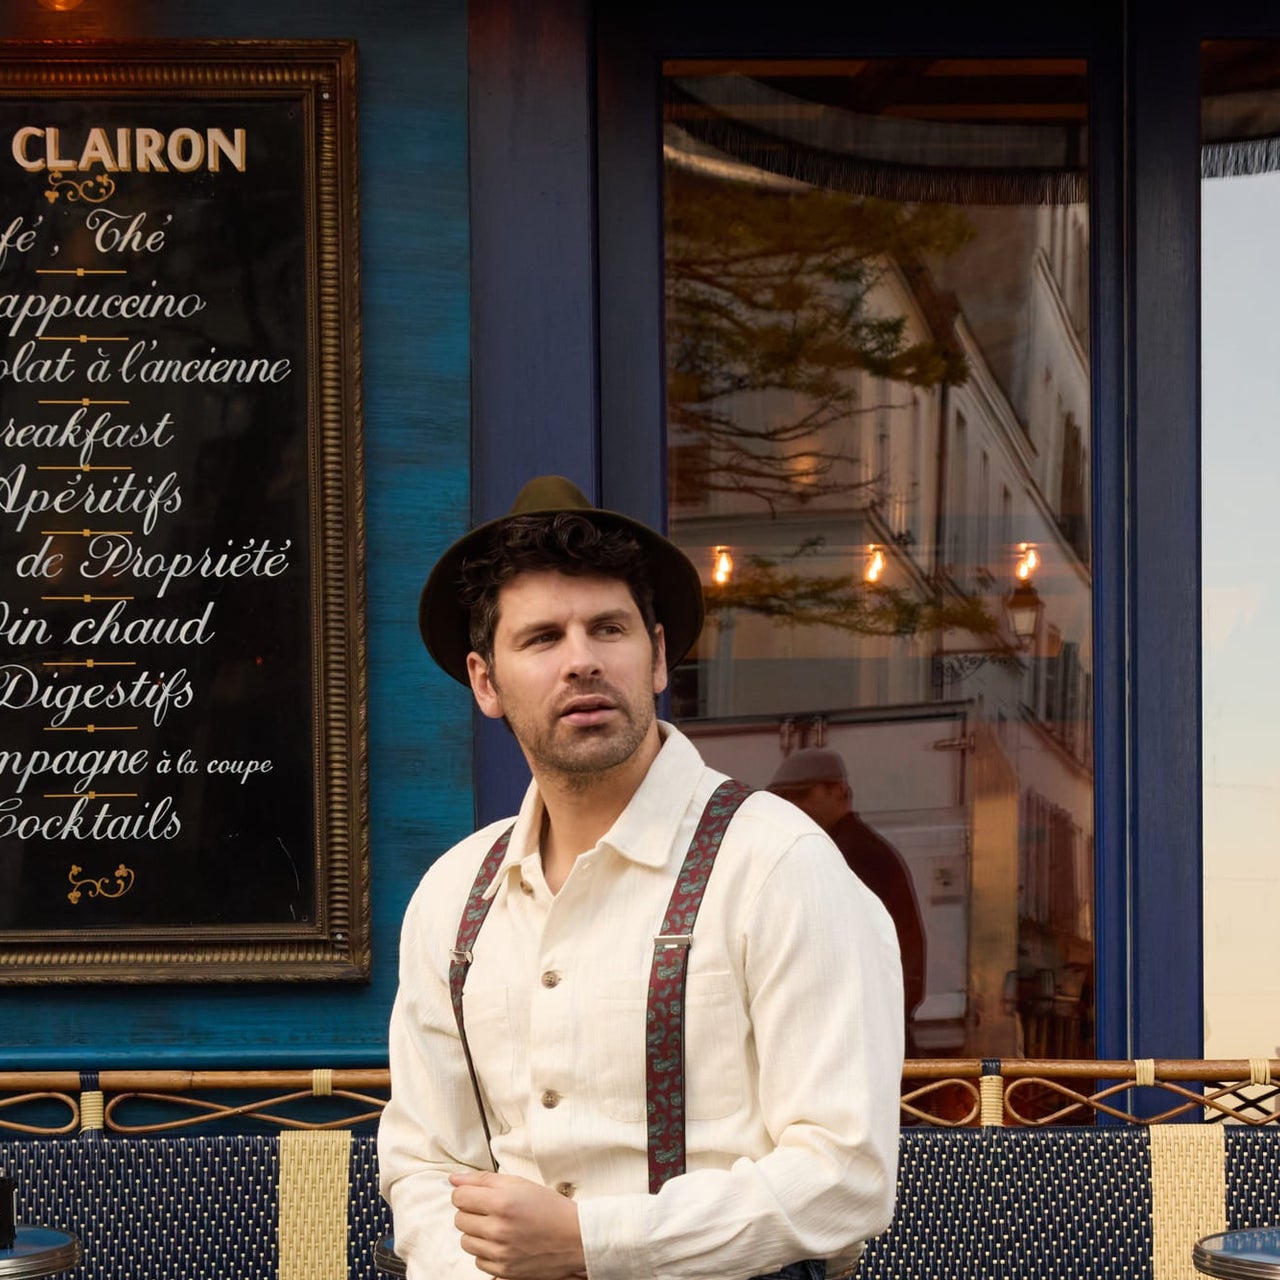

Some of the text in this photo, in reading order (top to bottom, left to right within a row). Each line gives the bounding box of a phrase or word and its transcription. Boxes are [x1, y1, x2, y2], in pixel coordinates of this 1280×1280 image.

[12, 126, 246, 172] CLAIRON
[86, 209, 172, 252] Thé
[87, 348, 111, 382] à
[122, 338, 291, 383] l'ancienne
[17, 535, 64, 577] de
[80, 533, 291, 598] Propriété
[65, 600, 215, 645] chaud
[177, 749, 198, 773] la
[207, 760, 273, 784] coupe
